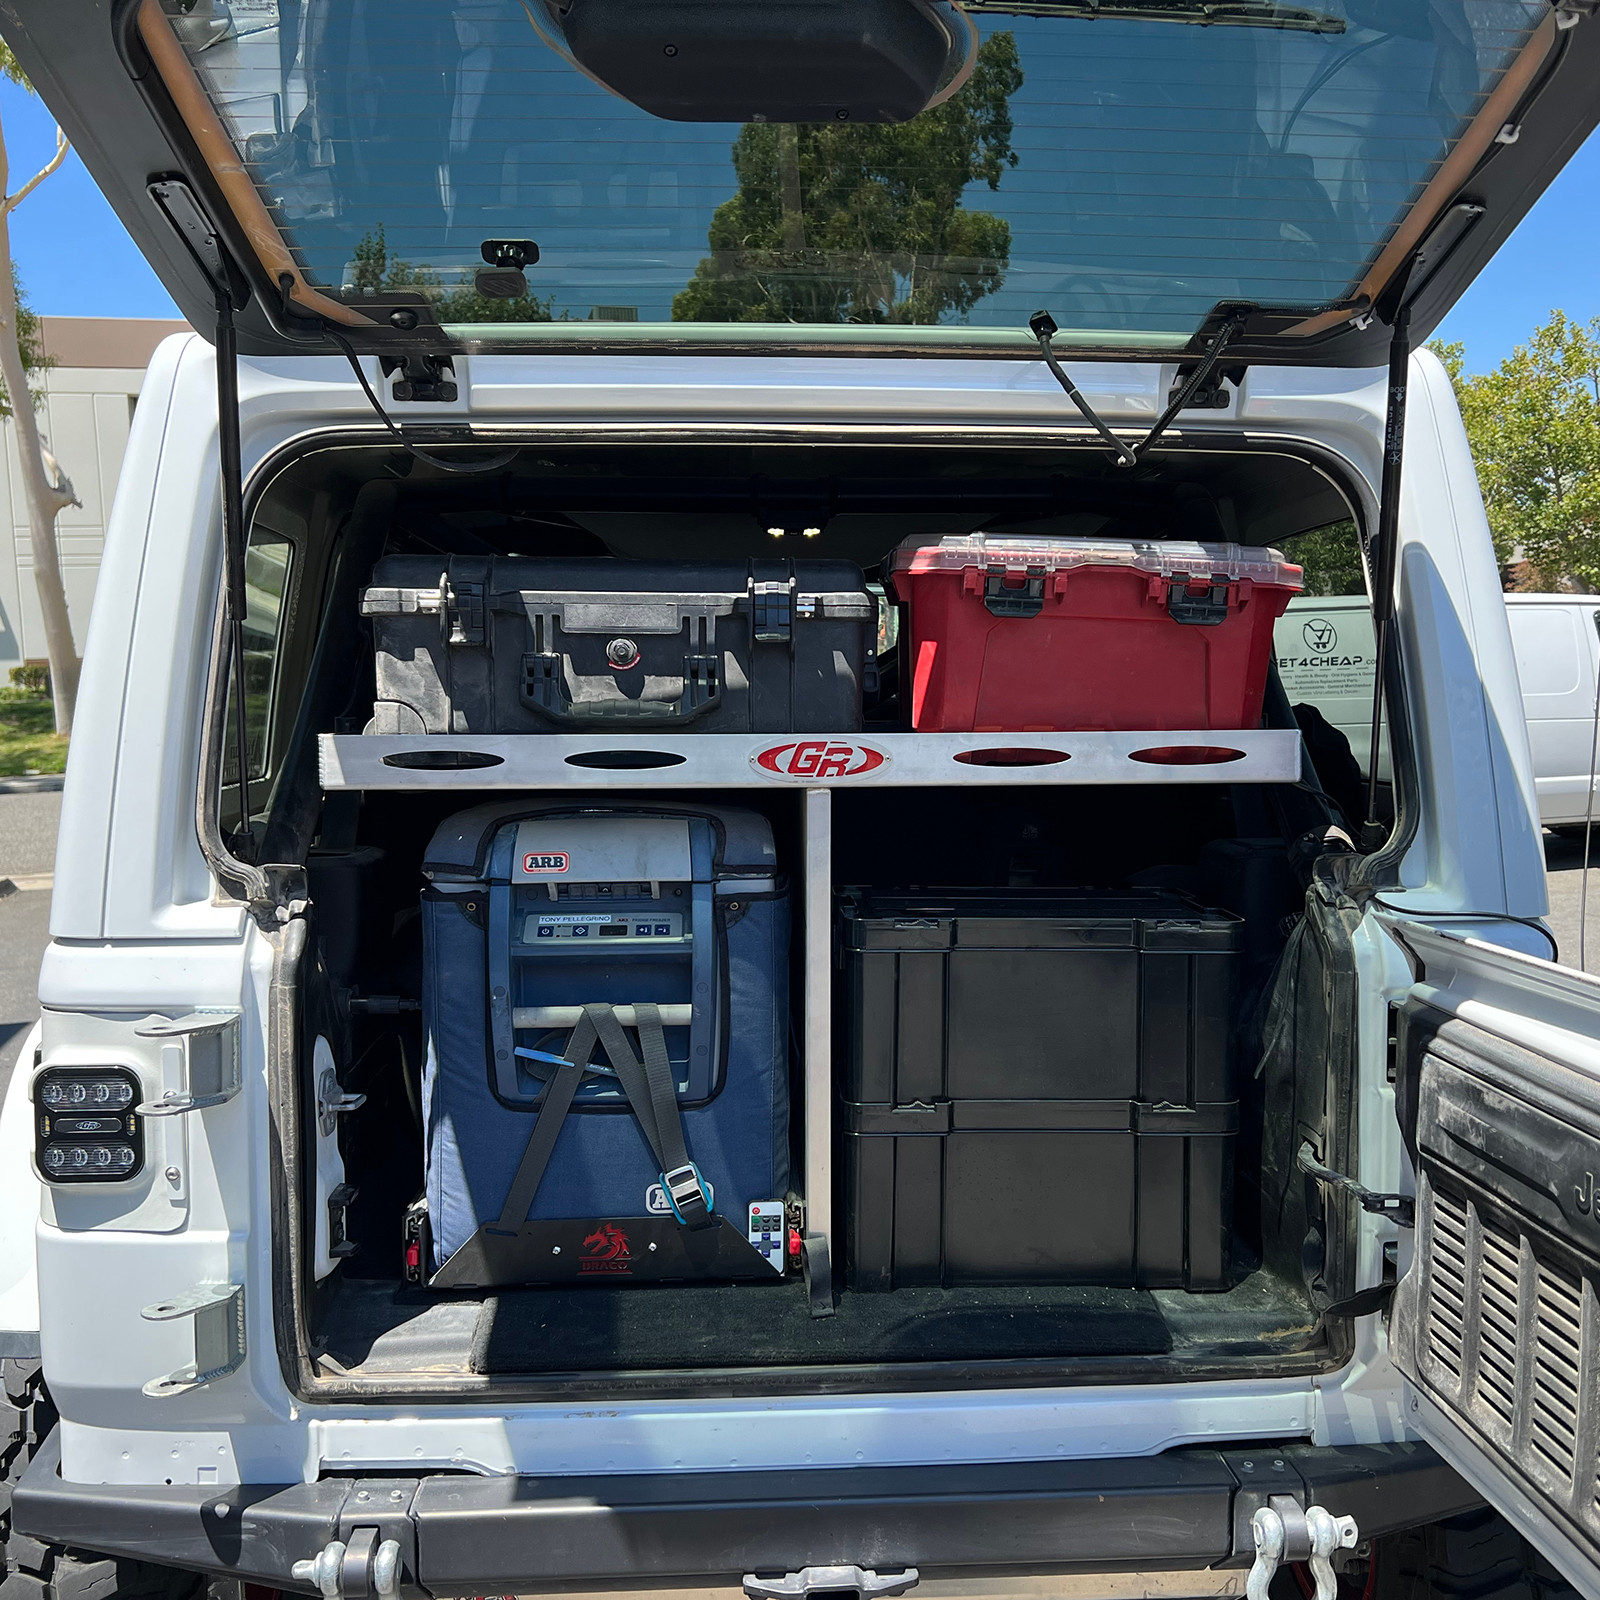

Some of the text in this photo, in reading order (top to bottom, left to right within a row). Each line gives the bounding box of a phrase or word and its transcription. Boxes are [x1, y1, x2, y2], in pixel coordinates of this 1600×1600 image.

[787, 741, 854, 777] GR
[528, 856, 564, 868] ARB
[582, 1261, 628, 1270] DRACO
